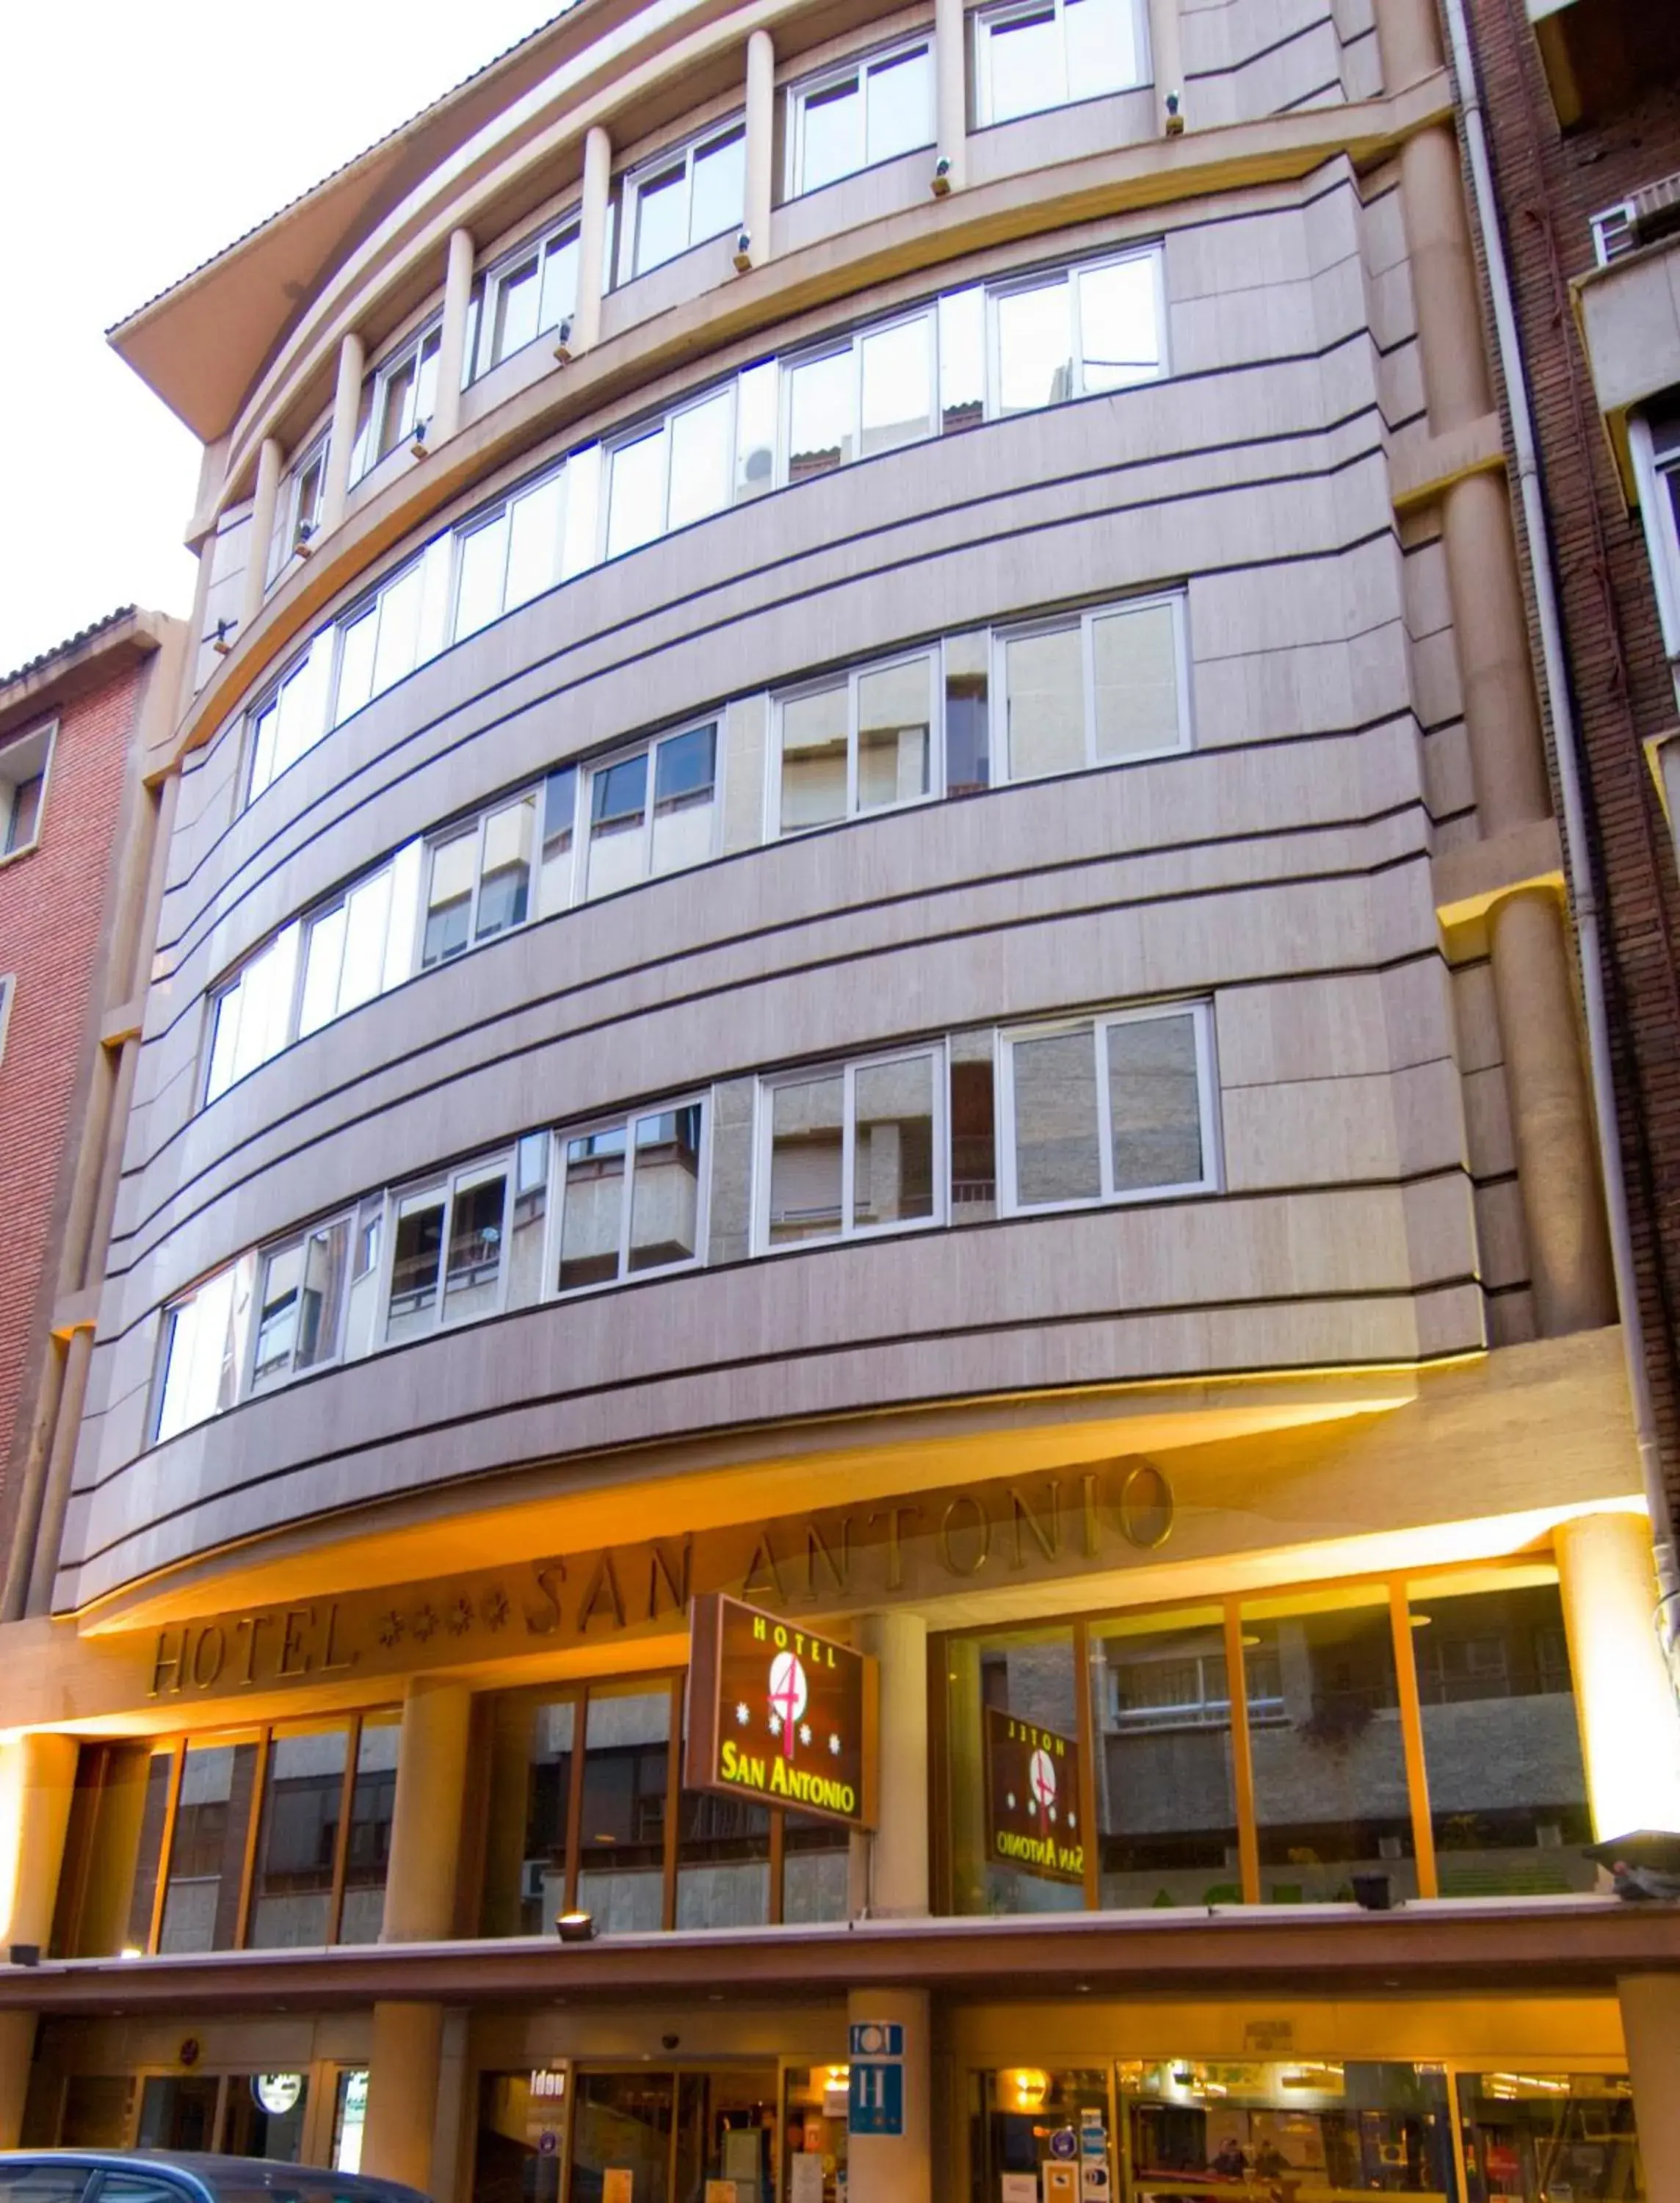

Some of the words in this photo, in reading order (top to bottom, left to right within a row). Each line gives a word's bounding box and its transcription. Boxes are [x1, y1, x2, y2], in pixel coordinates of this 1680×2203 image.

[148, 1603, 361, 1698] HOTEL
[526, 1532, 695, 1635] SAN
[741, 1468, 1175, 1604] ANTONIO
[753, 1616, 836, 1668] HOTEL
[722, 1740, 765, 1789] SAN
[770, 1757, 855, 1812] ANTONIO
